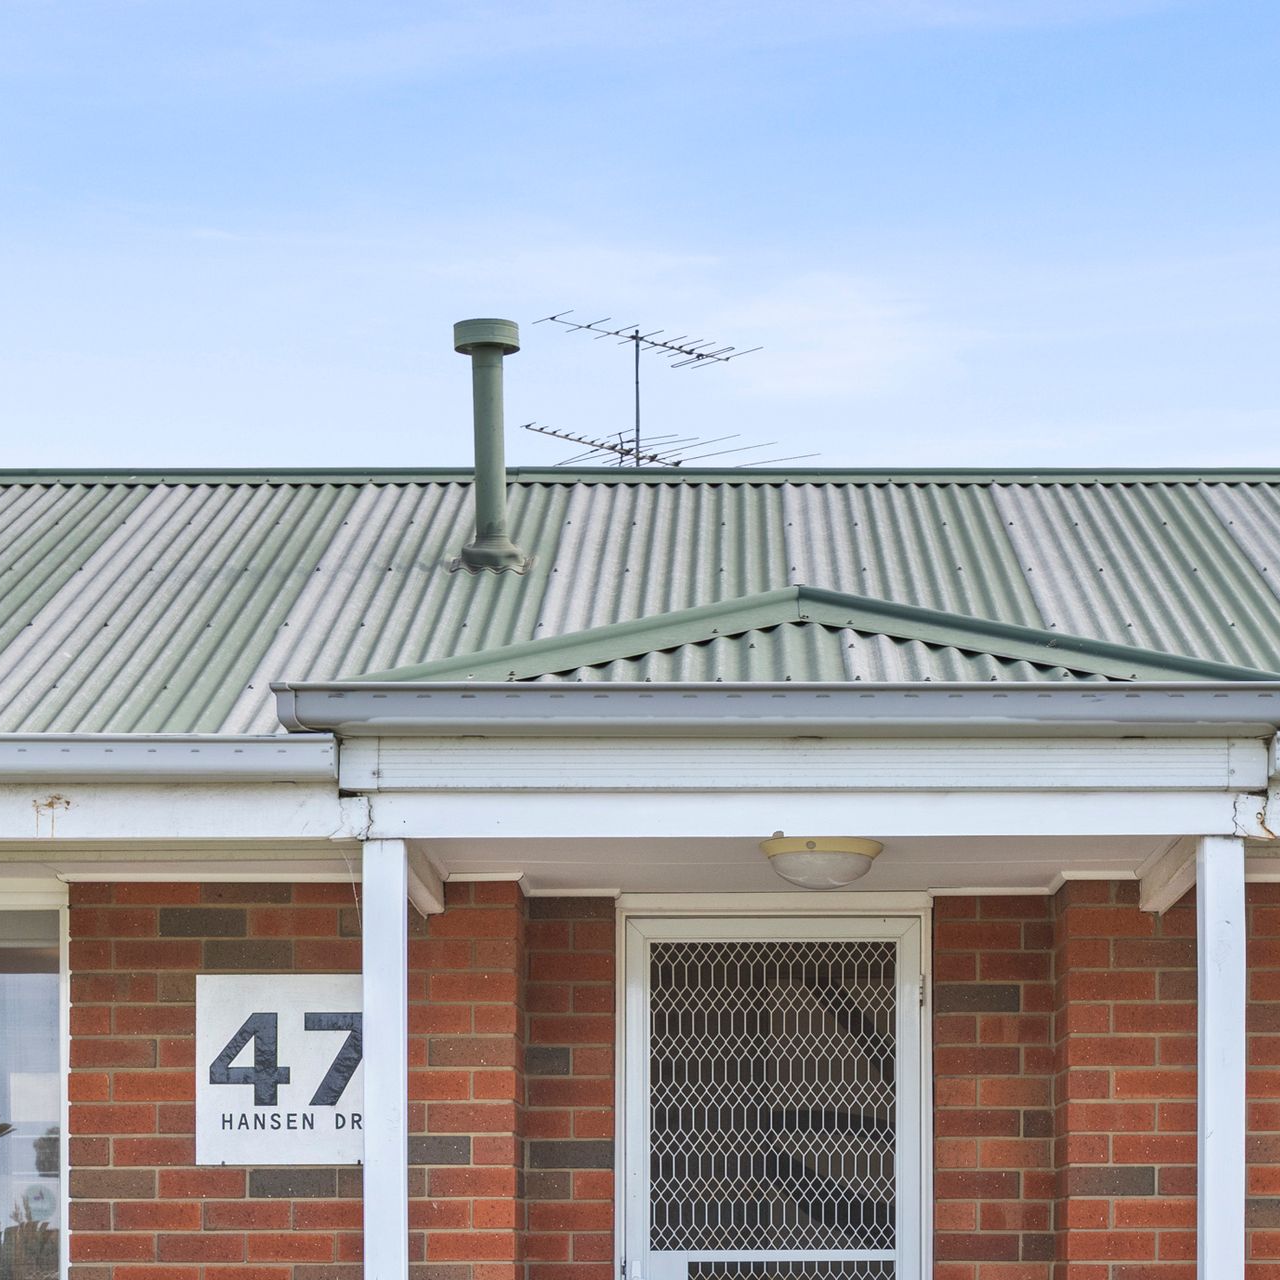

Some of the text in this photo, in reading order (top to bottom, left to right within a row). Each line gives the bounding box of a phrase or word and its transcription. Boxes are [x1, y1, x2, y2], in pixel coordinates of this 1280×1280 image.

[209, 1012, 363, 1106] 47
[221, 1113, 363, 1130] HANSEN DR
